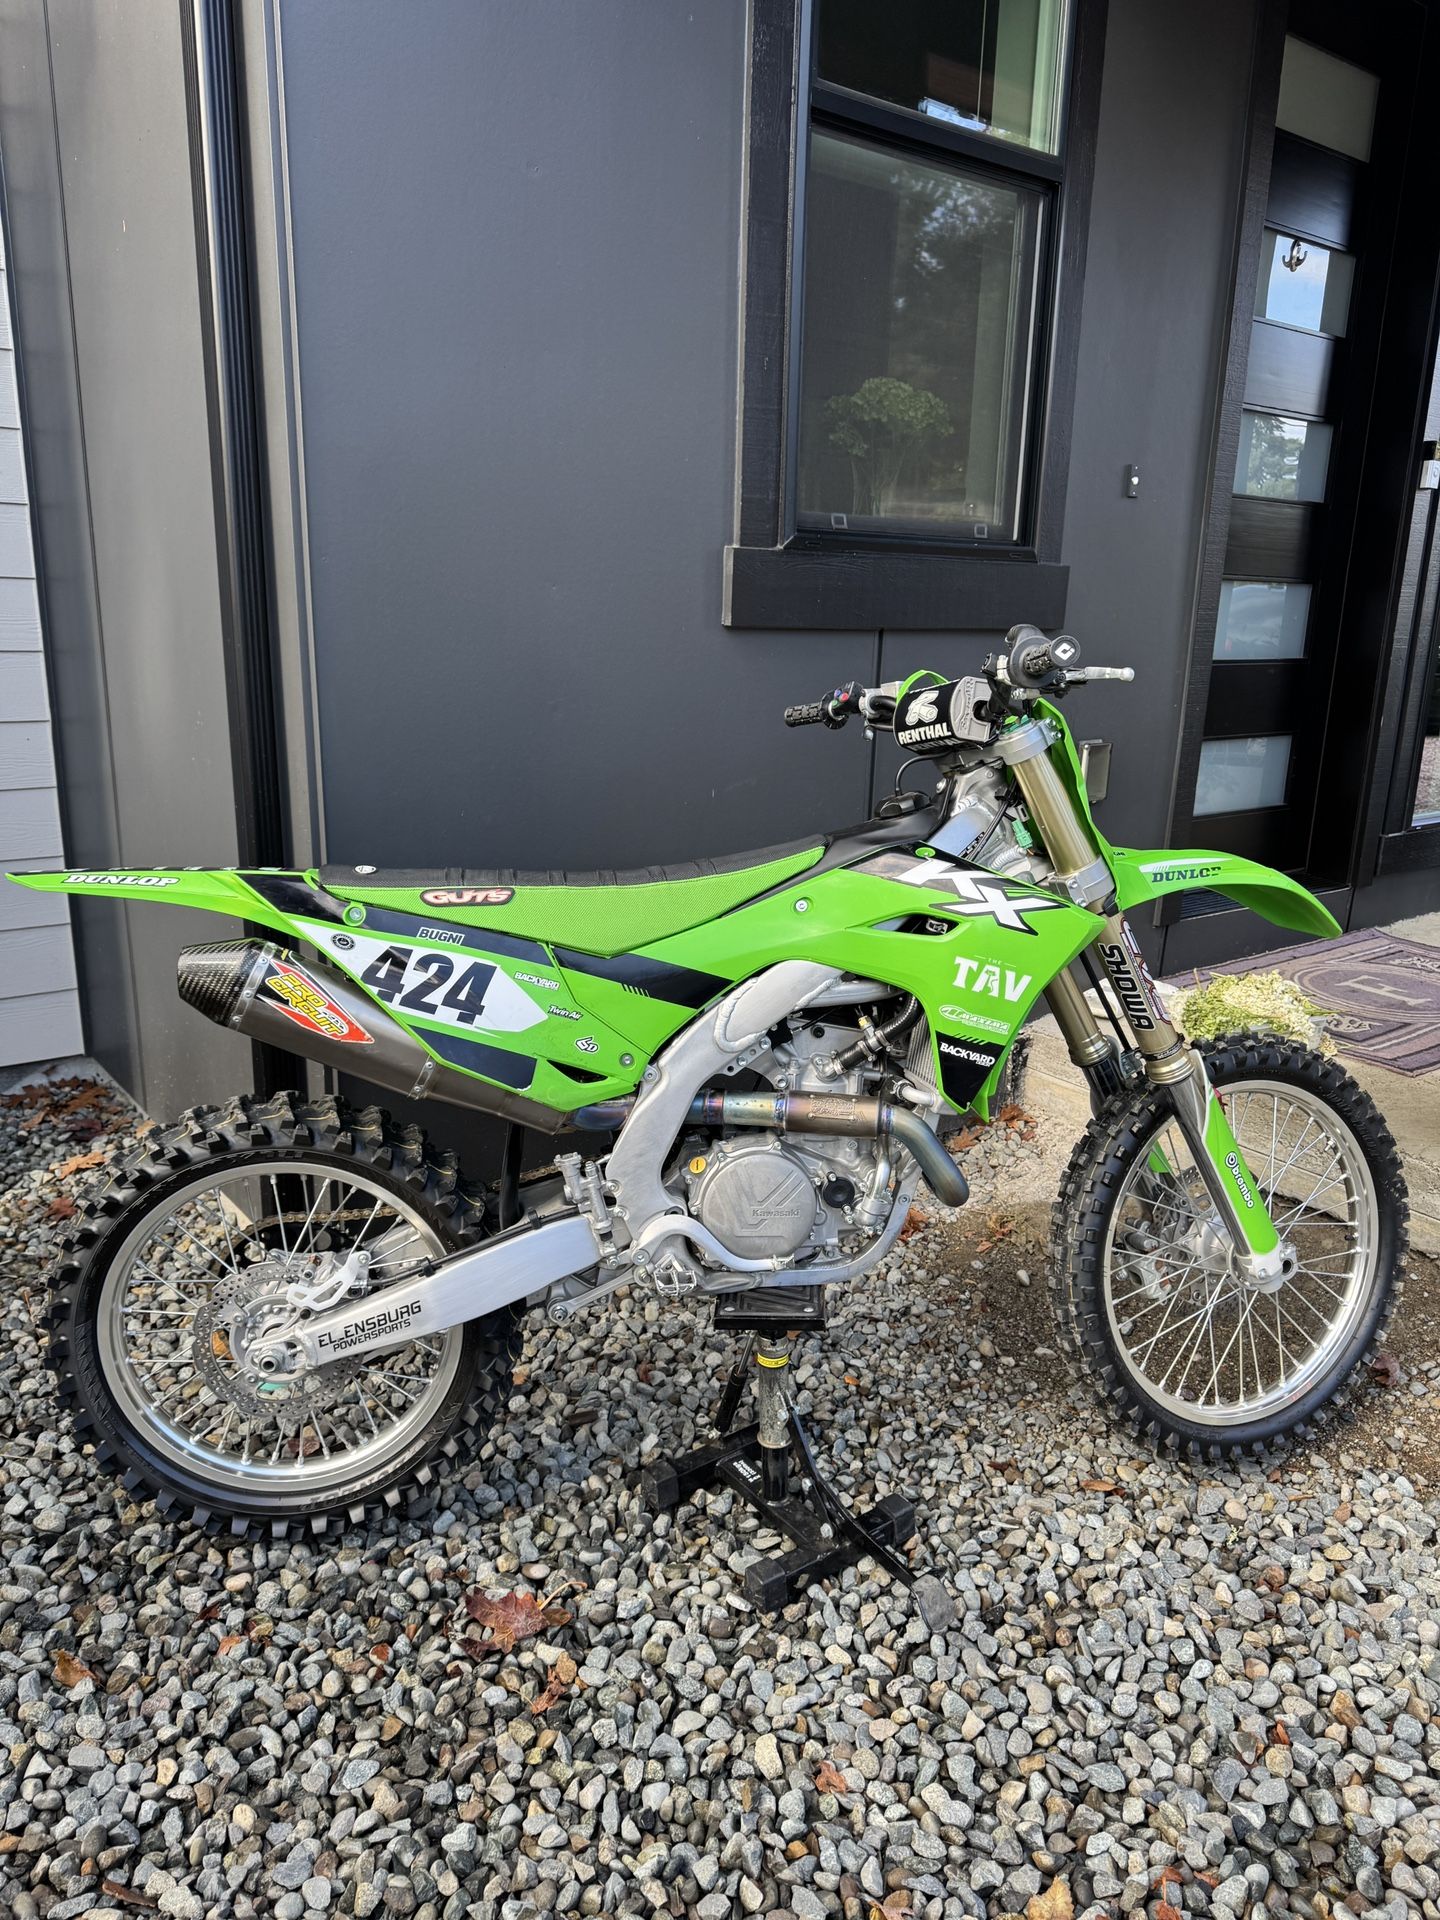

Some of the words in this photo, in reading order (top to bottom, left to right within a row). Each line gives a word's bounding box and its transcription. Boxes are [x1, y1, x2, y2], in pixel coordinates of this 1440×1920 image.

[898, 722, 952, 745] RENTHAL
[64, 873, 180, 887] DUNLOP
[423, 889, 512, 905] GUTS
[418, 927, 465, 945] BUGNI
[281, 973, 327, 1008] PRO
[360, 945, 498, 1026] 424
[514, 971, 560, 991] BACKYARD
[952, 955, 1032, 1003] TAV
[1098, 943, 1156, 1031] SHOWA
[267, 977, 344, 1035] CIRCUIT
[548, 1004, 569, 1017] Twin
[569, 1010, 583, 1021] Air
[940, 1042, 996, 1066] BACKYARD
[752, 1208, 801, 1218] Kawasaki
[333, 1318, 411, 1352] POWERSPORTS
